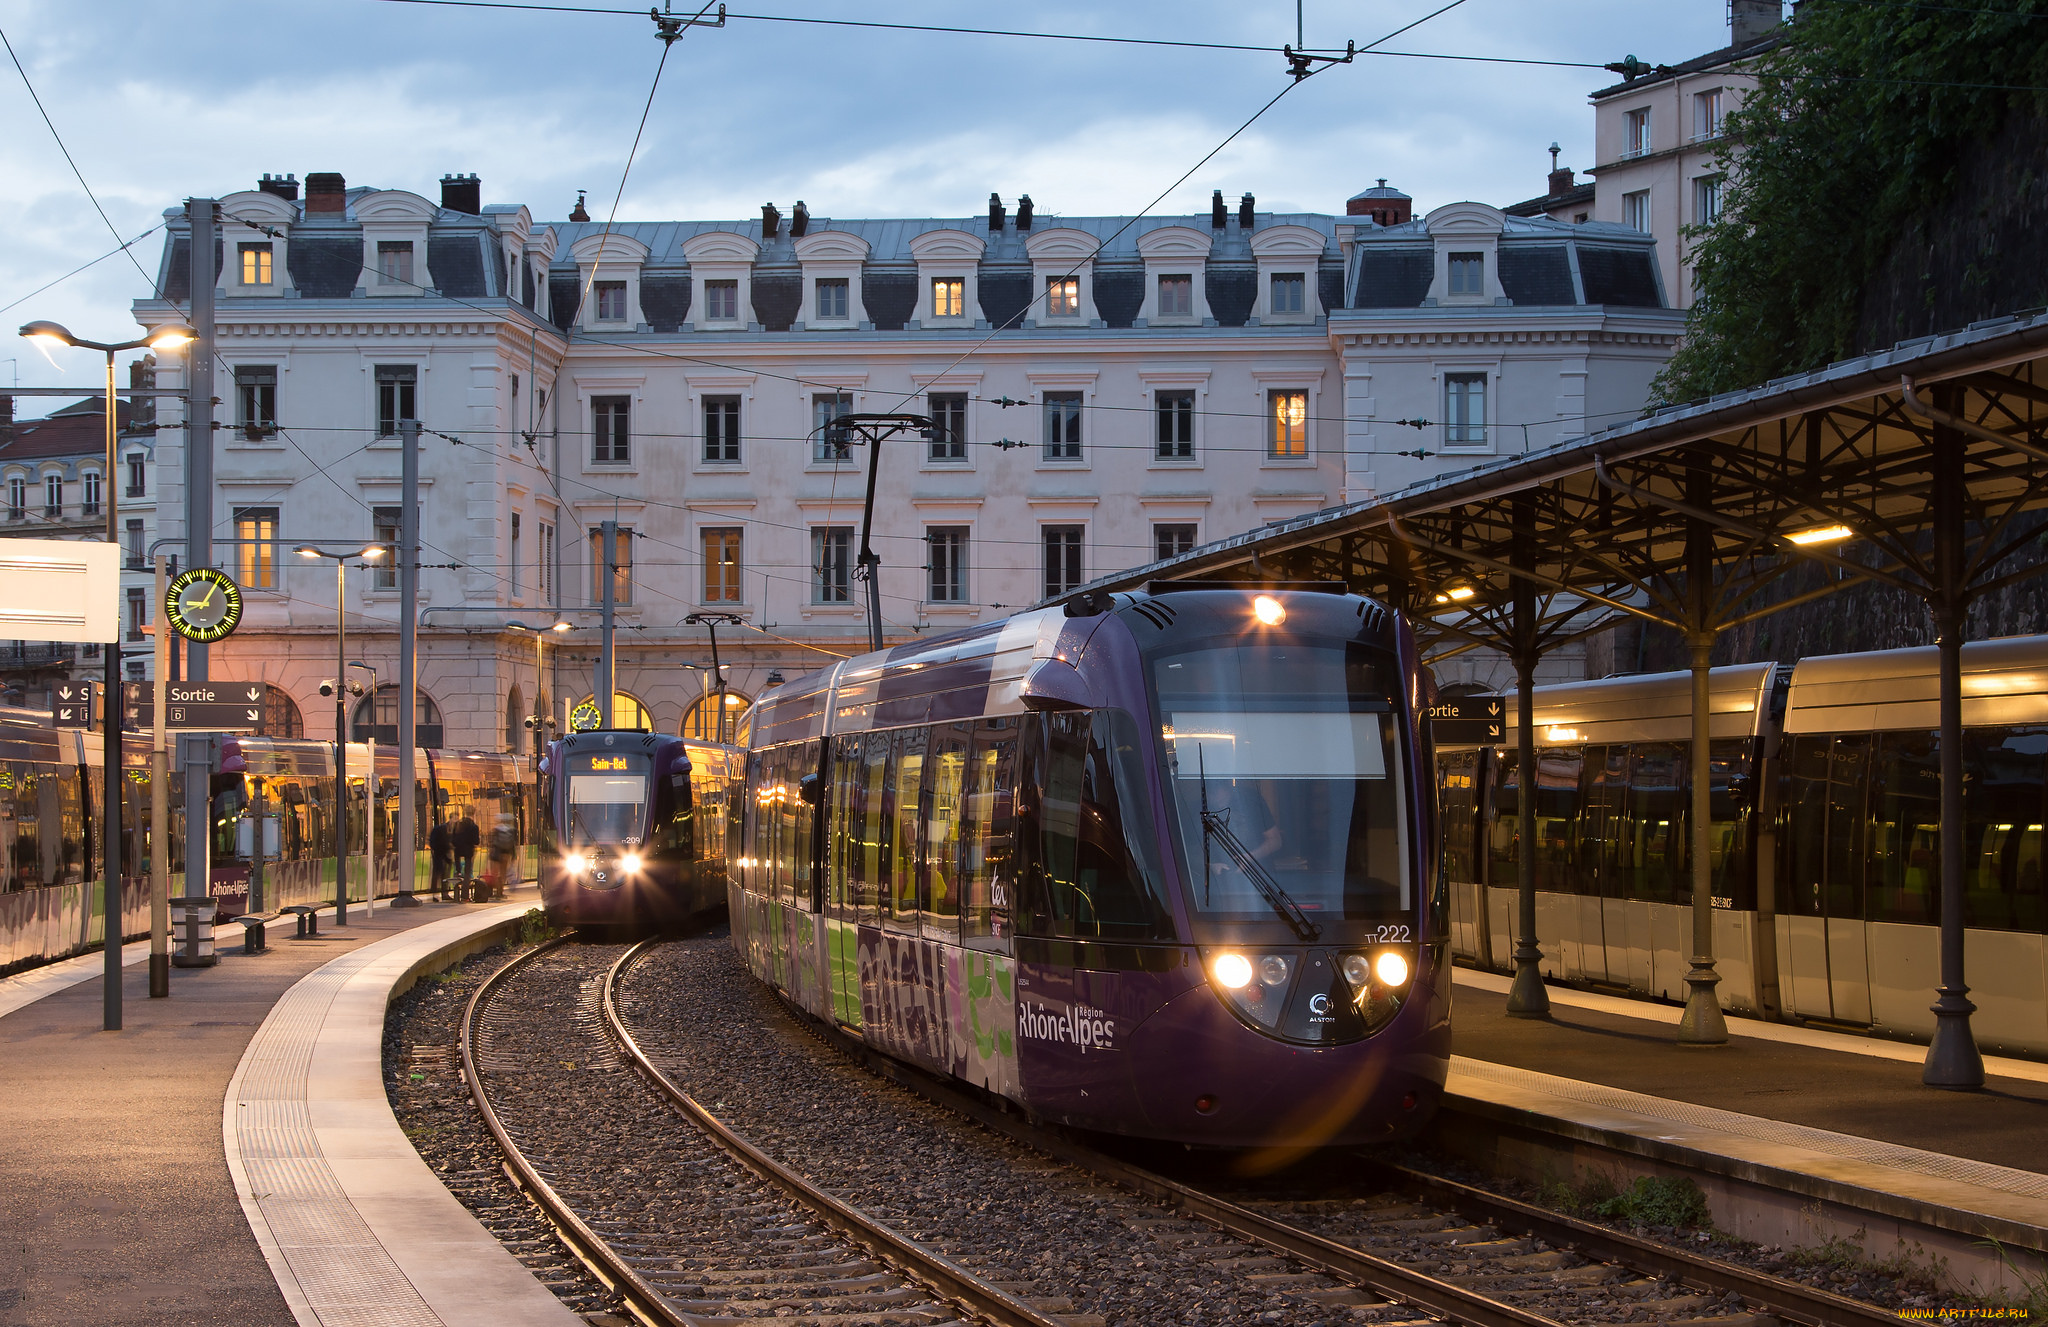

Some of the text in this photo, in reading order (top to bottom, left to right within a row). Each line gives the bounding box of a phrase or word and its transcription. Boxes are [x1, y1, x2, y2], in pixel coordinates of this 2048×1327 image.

[171, 687, 215, 701] Sortie
[174, 712, 182, 720] D
[1428, 703, 1459, 717] ortie
[592, 757, 627, 770] Sain-Bel
[1079, 1005, 1104, 1020] Région
